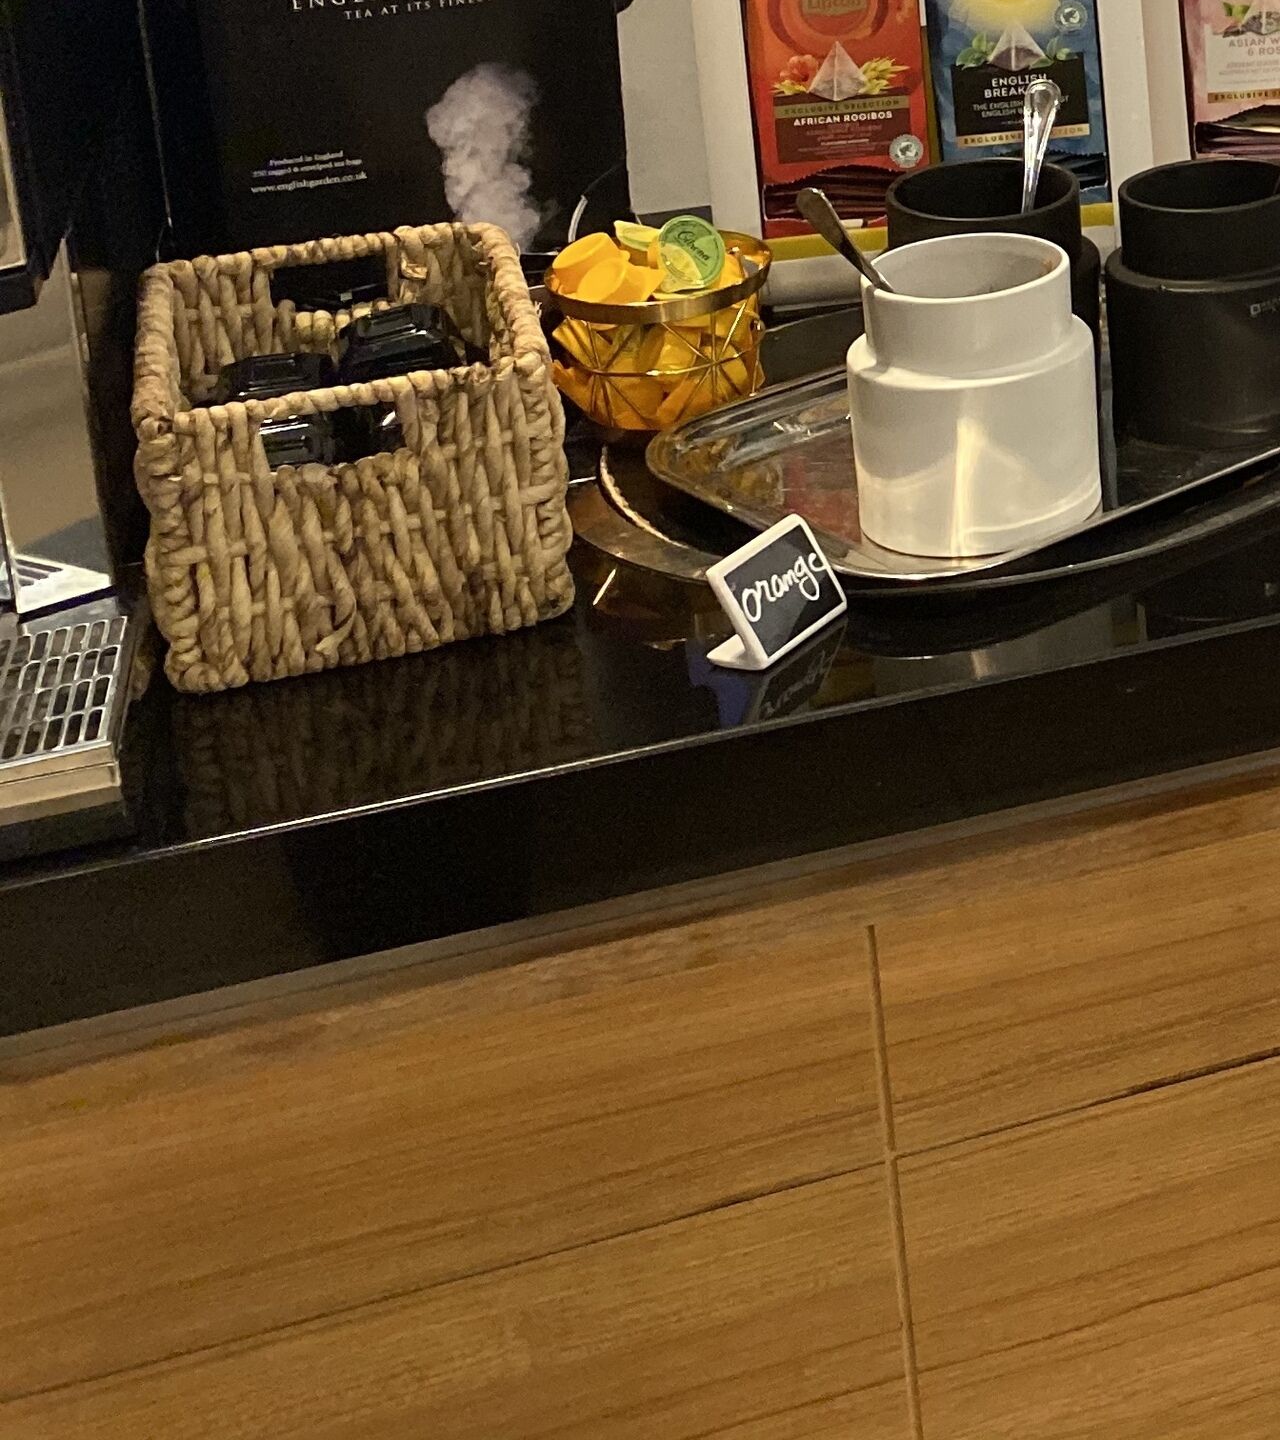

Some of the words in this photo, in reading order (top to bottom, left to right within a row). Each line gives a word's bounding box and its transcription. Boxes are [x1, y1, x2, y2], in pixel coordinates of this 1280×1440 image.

[344, 9, 373, 20] TEA
[381, 5, 398, 15] AT
[407, 1, 431, 12] ITS
[1228, 37, 1266, 48] ASIAN
[992, 73, 1047, 87] ENGLISH
[1214, 91, 1269, 100] EXCLUSIVE
[793, 116, 840, 126] AFRICAN
[843, 111, 893, 122] ROOIBOS
[964, 134, 1021, 145] EXCLUSIVE
